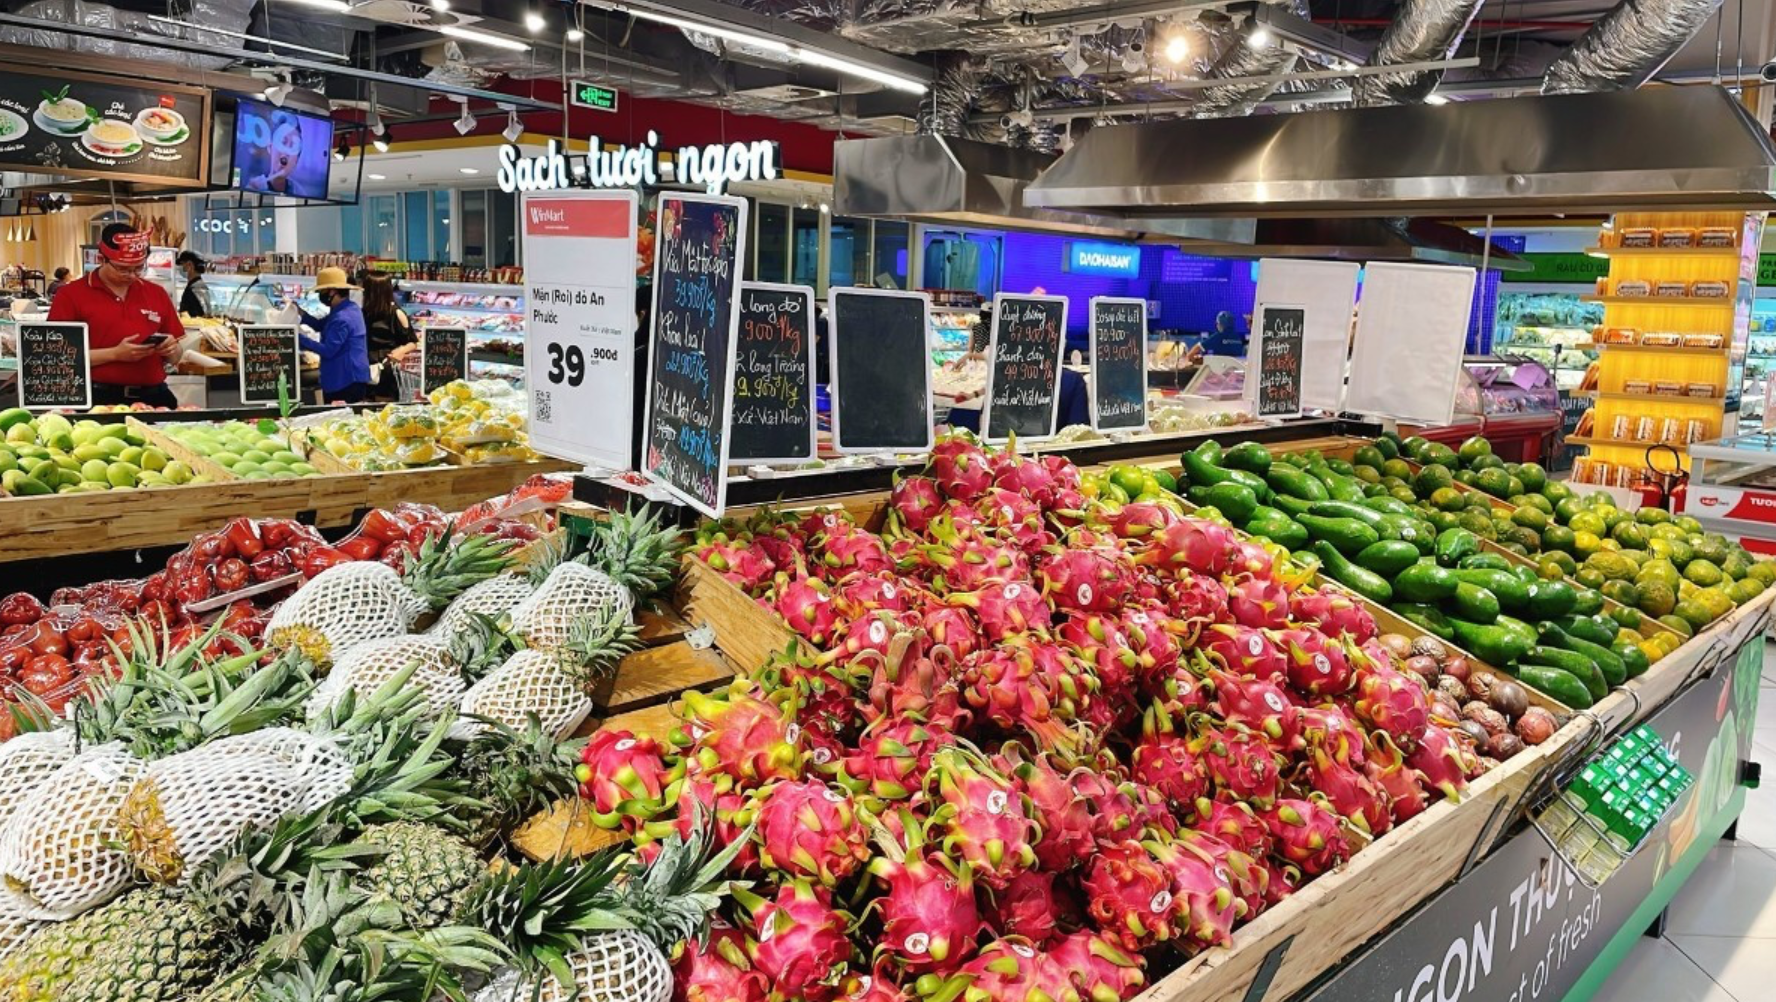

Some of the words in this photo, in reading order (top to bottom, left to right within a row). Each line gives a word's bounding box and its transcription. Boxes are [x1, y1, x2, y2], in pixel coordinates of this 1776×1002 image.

[588, 129, 657, 187] tươi
[677, 139, 776, 195] ngon
[552, 290, 573, 306] (Roi)
[590, 292, 605, 306] An
[547, 342, 585, 388] 39
[1394, 906, 1498, 1002] GON
[1532, 933, 1556, 999] of
[1557, 889, 1602, 970] fresh
